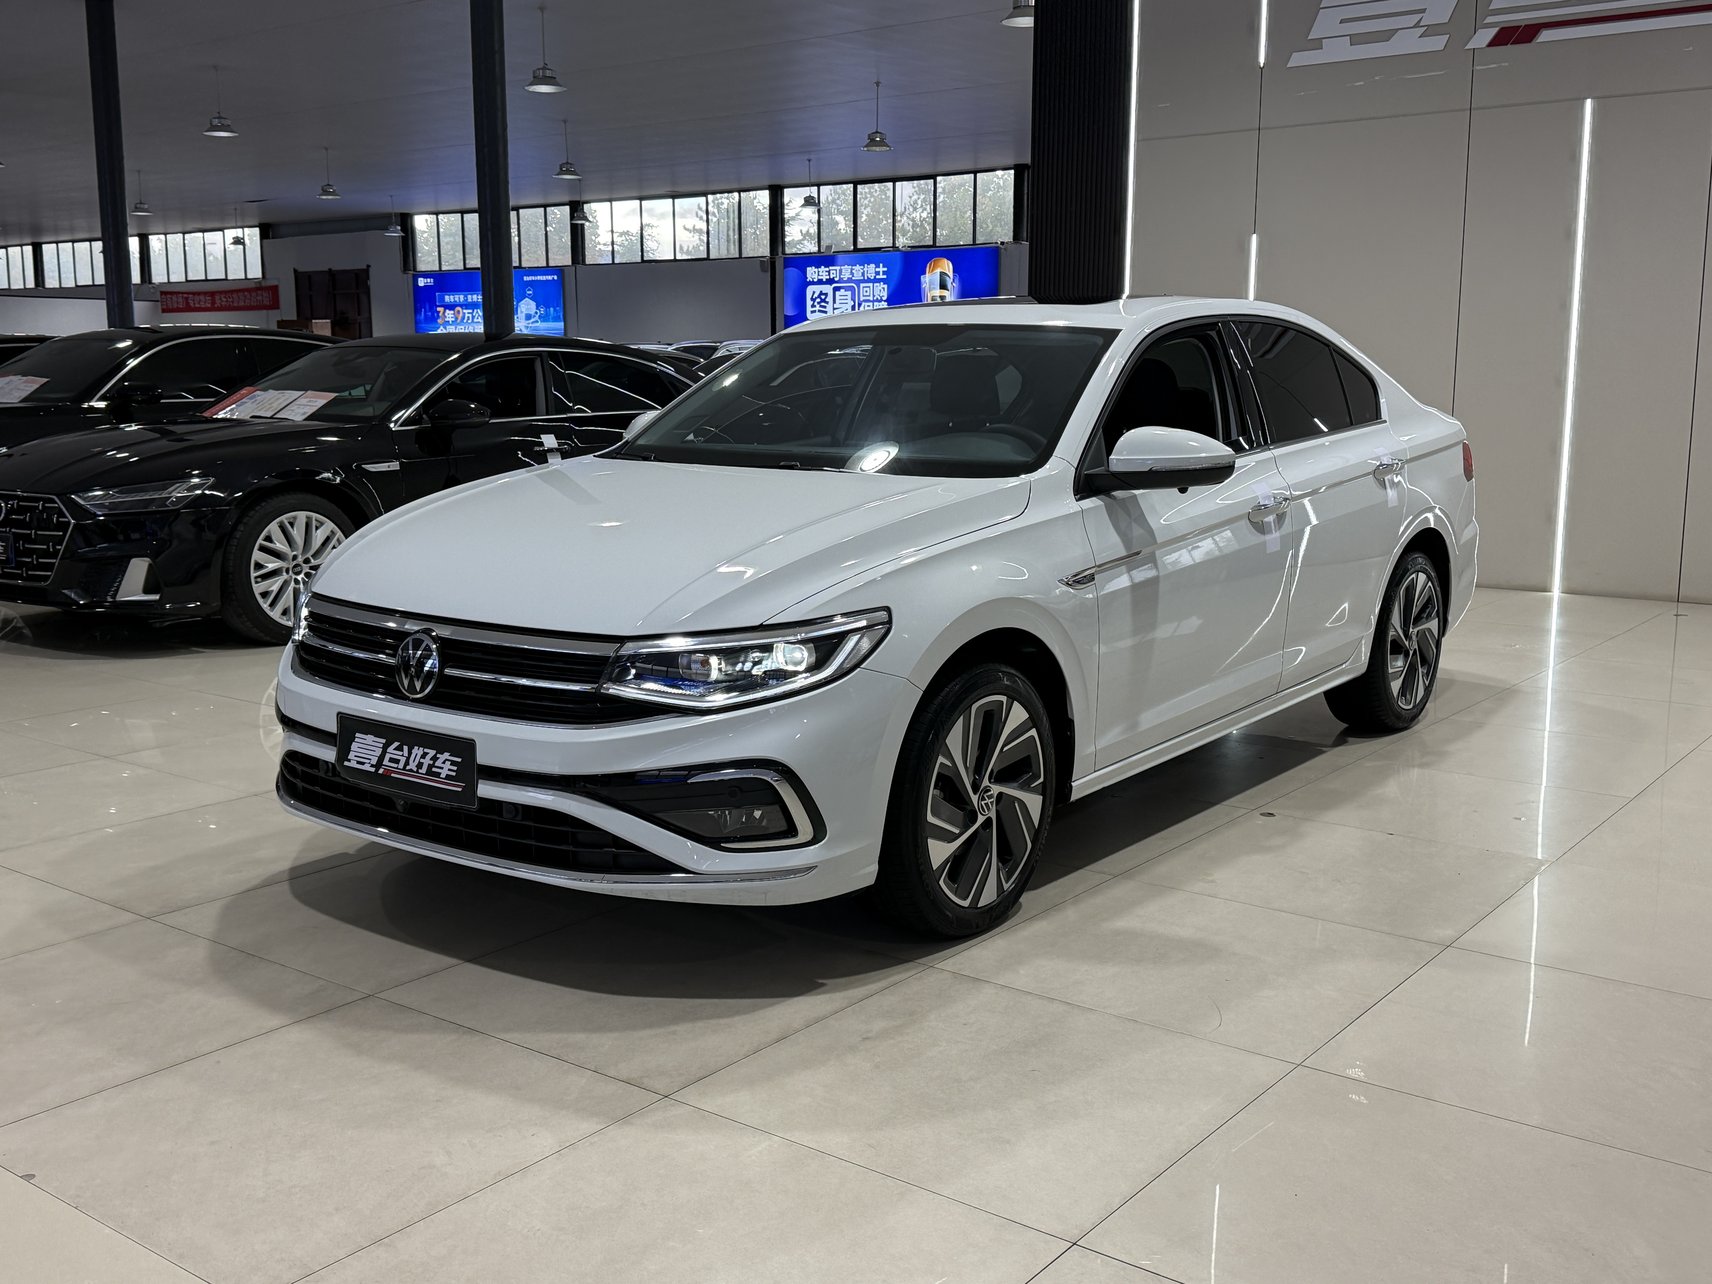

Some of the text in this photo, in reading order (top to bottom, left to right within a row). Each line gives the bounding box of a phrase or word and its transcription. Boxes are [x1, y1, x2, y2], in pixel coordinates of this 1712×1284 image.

[806, 264, 888, 282] 购车可享查博士
[860, 282, 888, 300] 回购
[343, 732, 463, 779] 壹台好车
